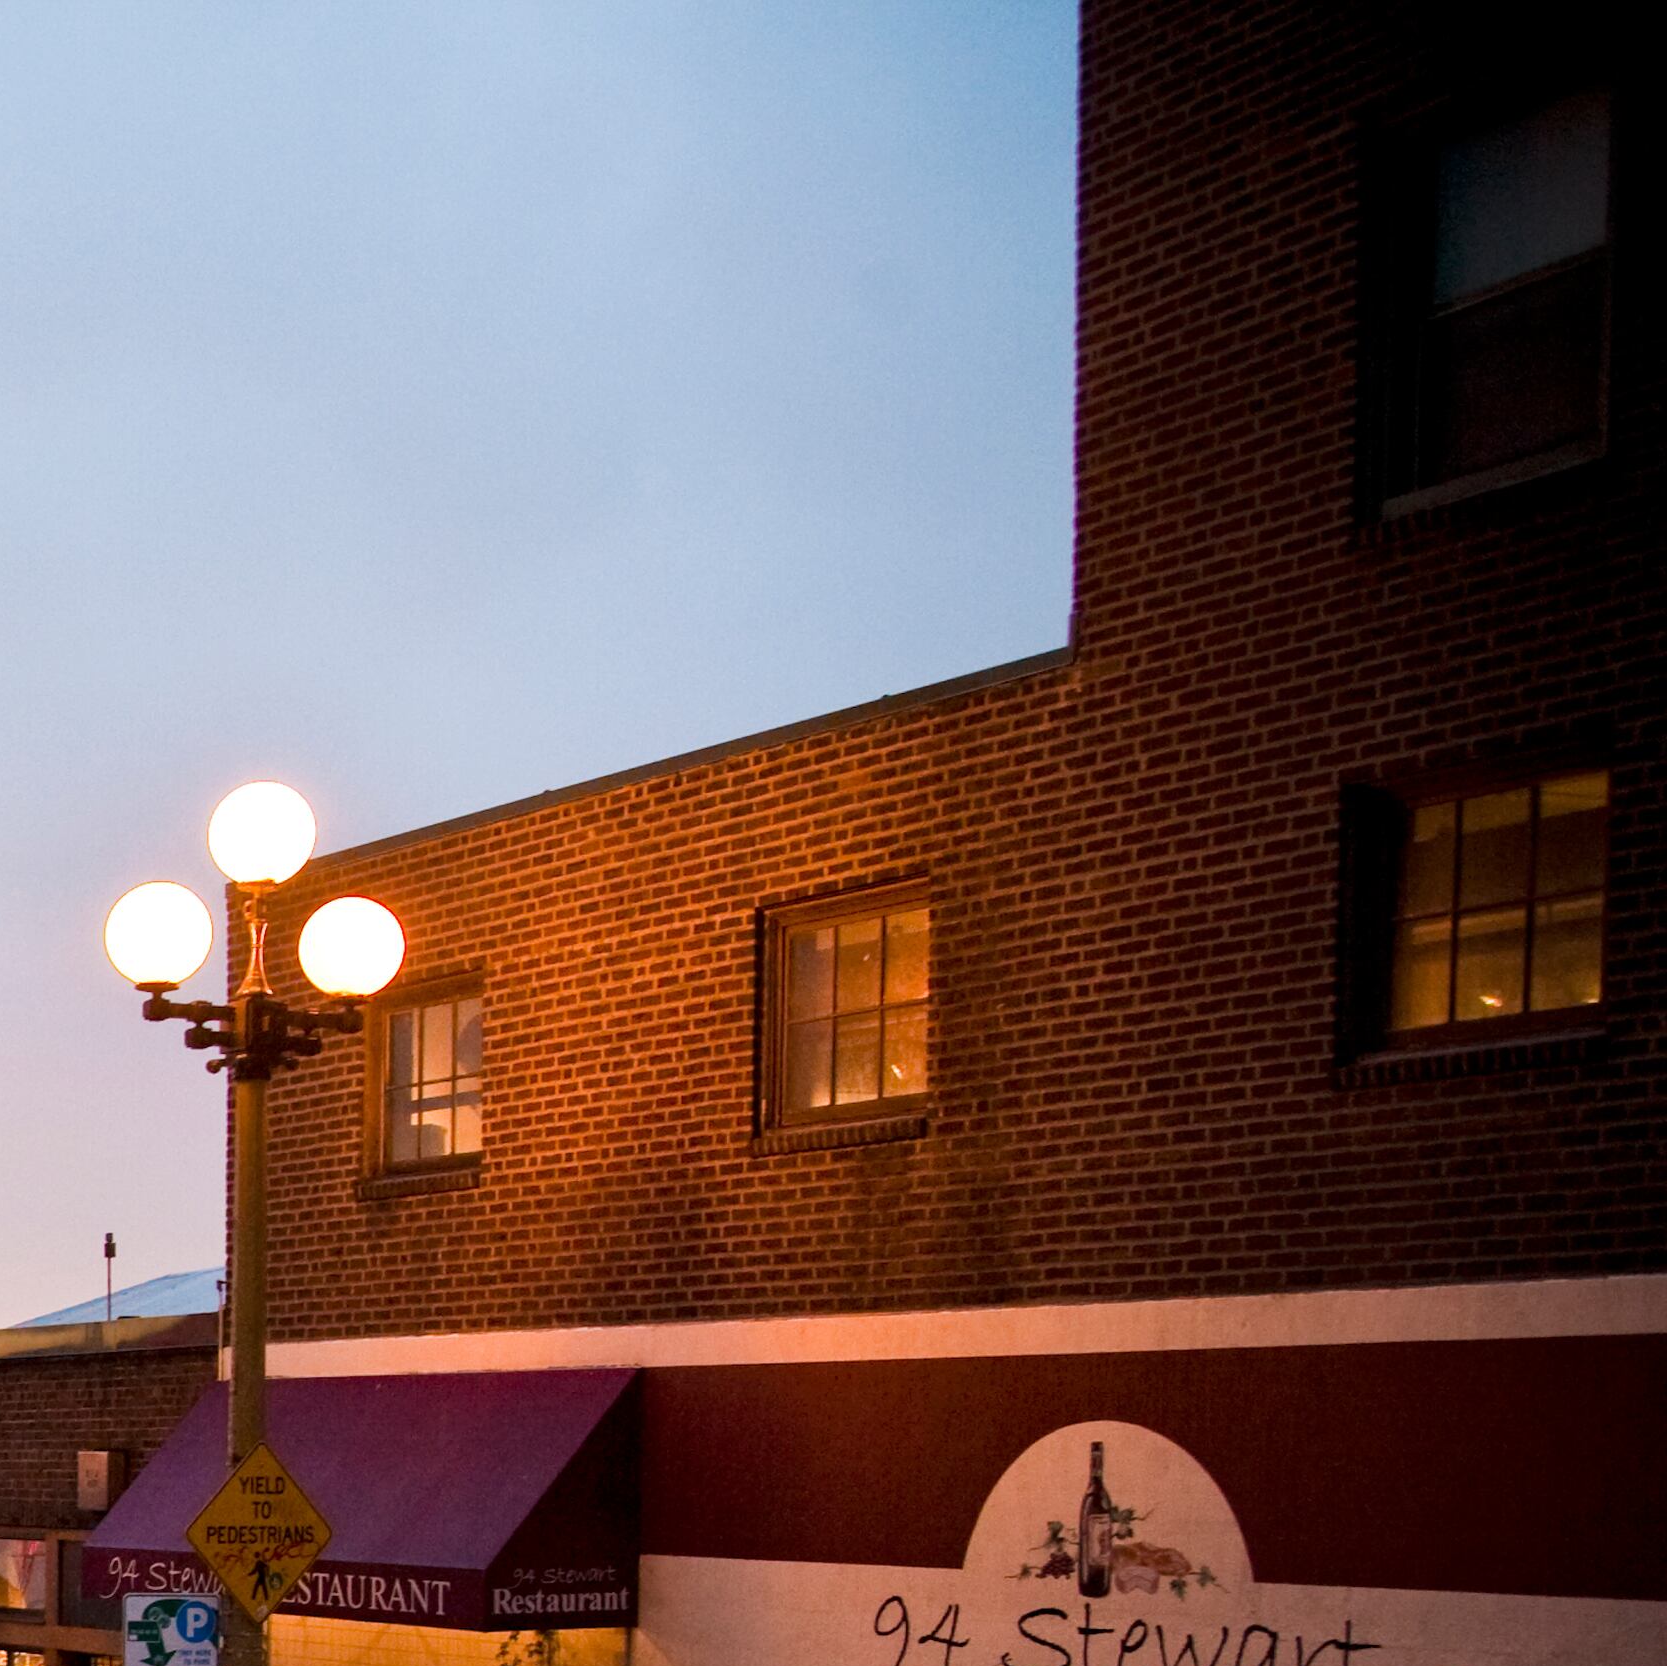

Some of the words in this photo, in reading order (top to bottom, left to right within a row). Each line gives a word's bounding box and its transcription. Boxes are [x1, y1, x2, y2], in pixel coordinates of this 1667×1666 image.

[239, 1476, 285, 1494] YIELD
[252, 1502, 272, 1519] TO
[206, 1526, 315, 1544] PEDESTRIANS
[99, 1556, 140, 1599] 94
[508, 1568, 536, 1589] 94
[541, 1566, 617, 1584] Stewart
[282, 1572, 451, 1616] STAURANT
[492, 1586, 630, 1615] Restaurant
[187, 1607, 209, 1638] P
